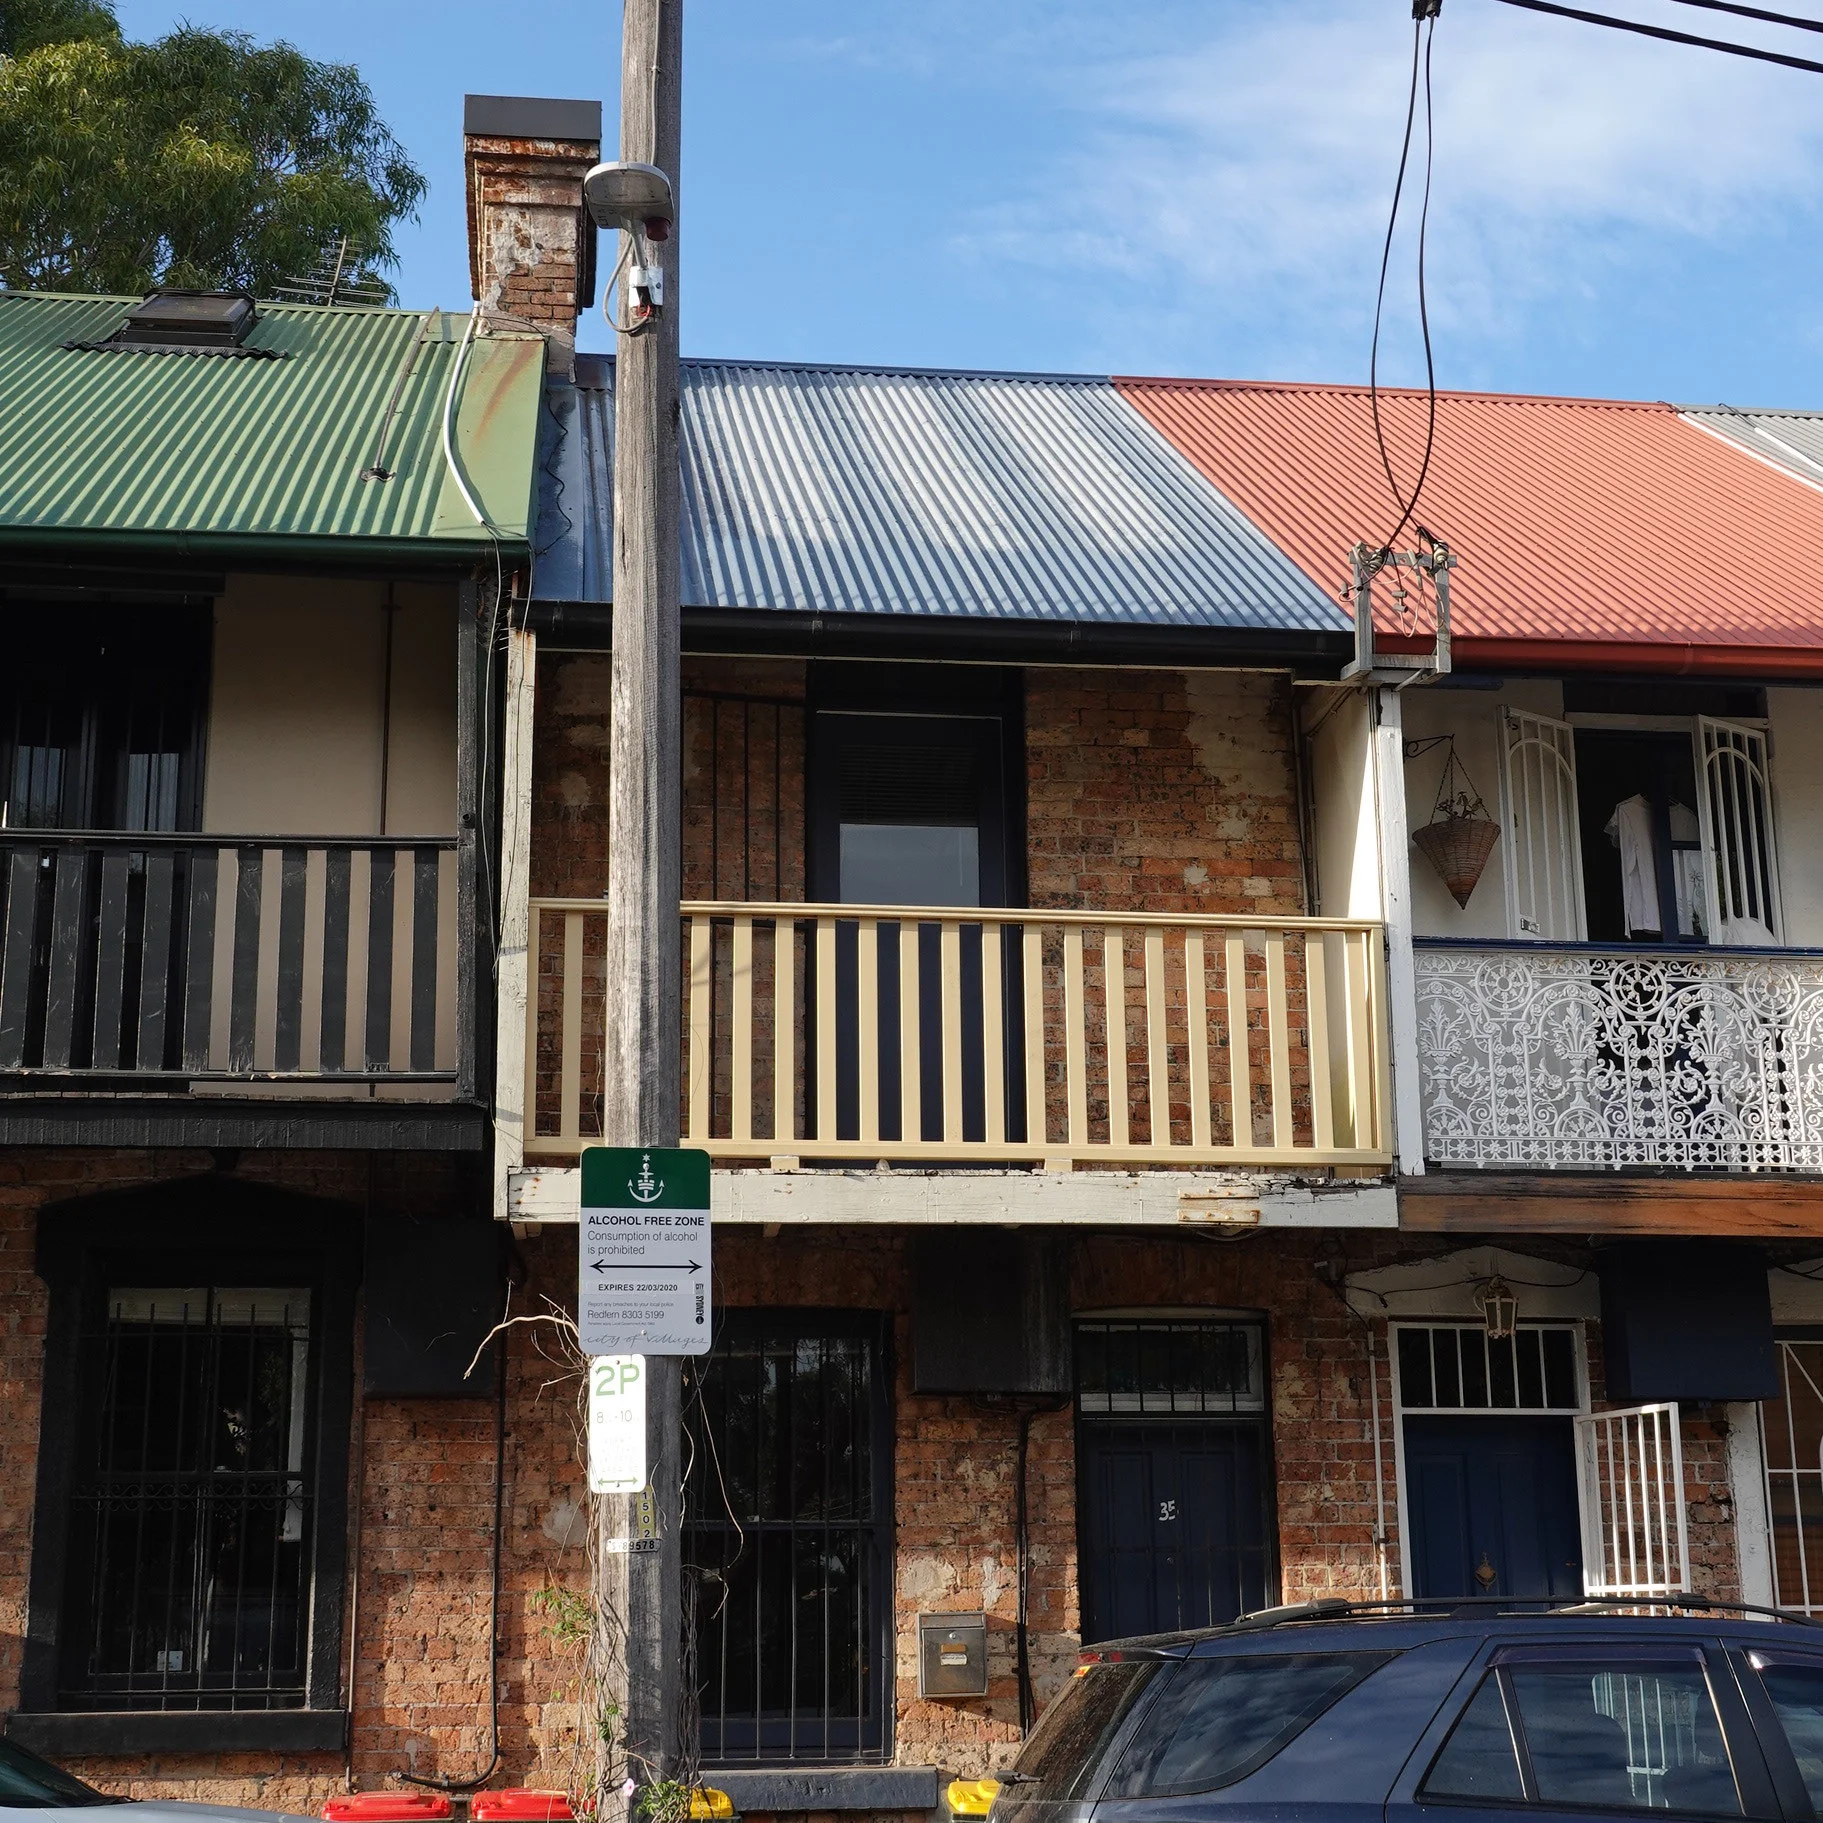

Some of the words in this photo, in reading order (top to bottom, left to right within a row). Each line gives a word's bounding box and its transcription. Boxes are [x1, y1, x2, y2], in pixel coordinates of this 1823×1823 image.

[588, 1216, 642, 1226] ALCOHOL
[644, 1216, 672, 1226] FREE
[674, 1216, 705, 1226] ZONE
[587, 1230, 650, 1243] Consumption
[652, 1231, 662, 1241] of
[664, 1231, 698, 1241] alcohol
[587, 1244, 596, 1254] is
[598, 1245, 645, 1256] prohibited
[598, 1283, 634, 1291] EXPIRES
[587, 1309, 620, 1319] Redfern
[621, 1310, 643, 1319] 8303
[645, 1310, 665, 1319] 5199
[595, 1363, 640, 1397] 2P
[1159, 1500, 1179, 1521] 35
